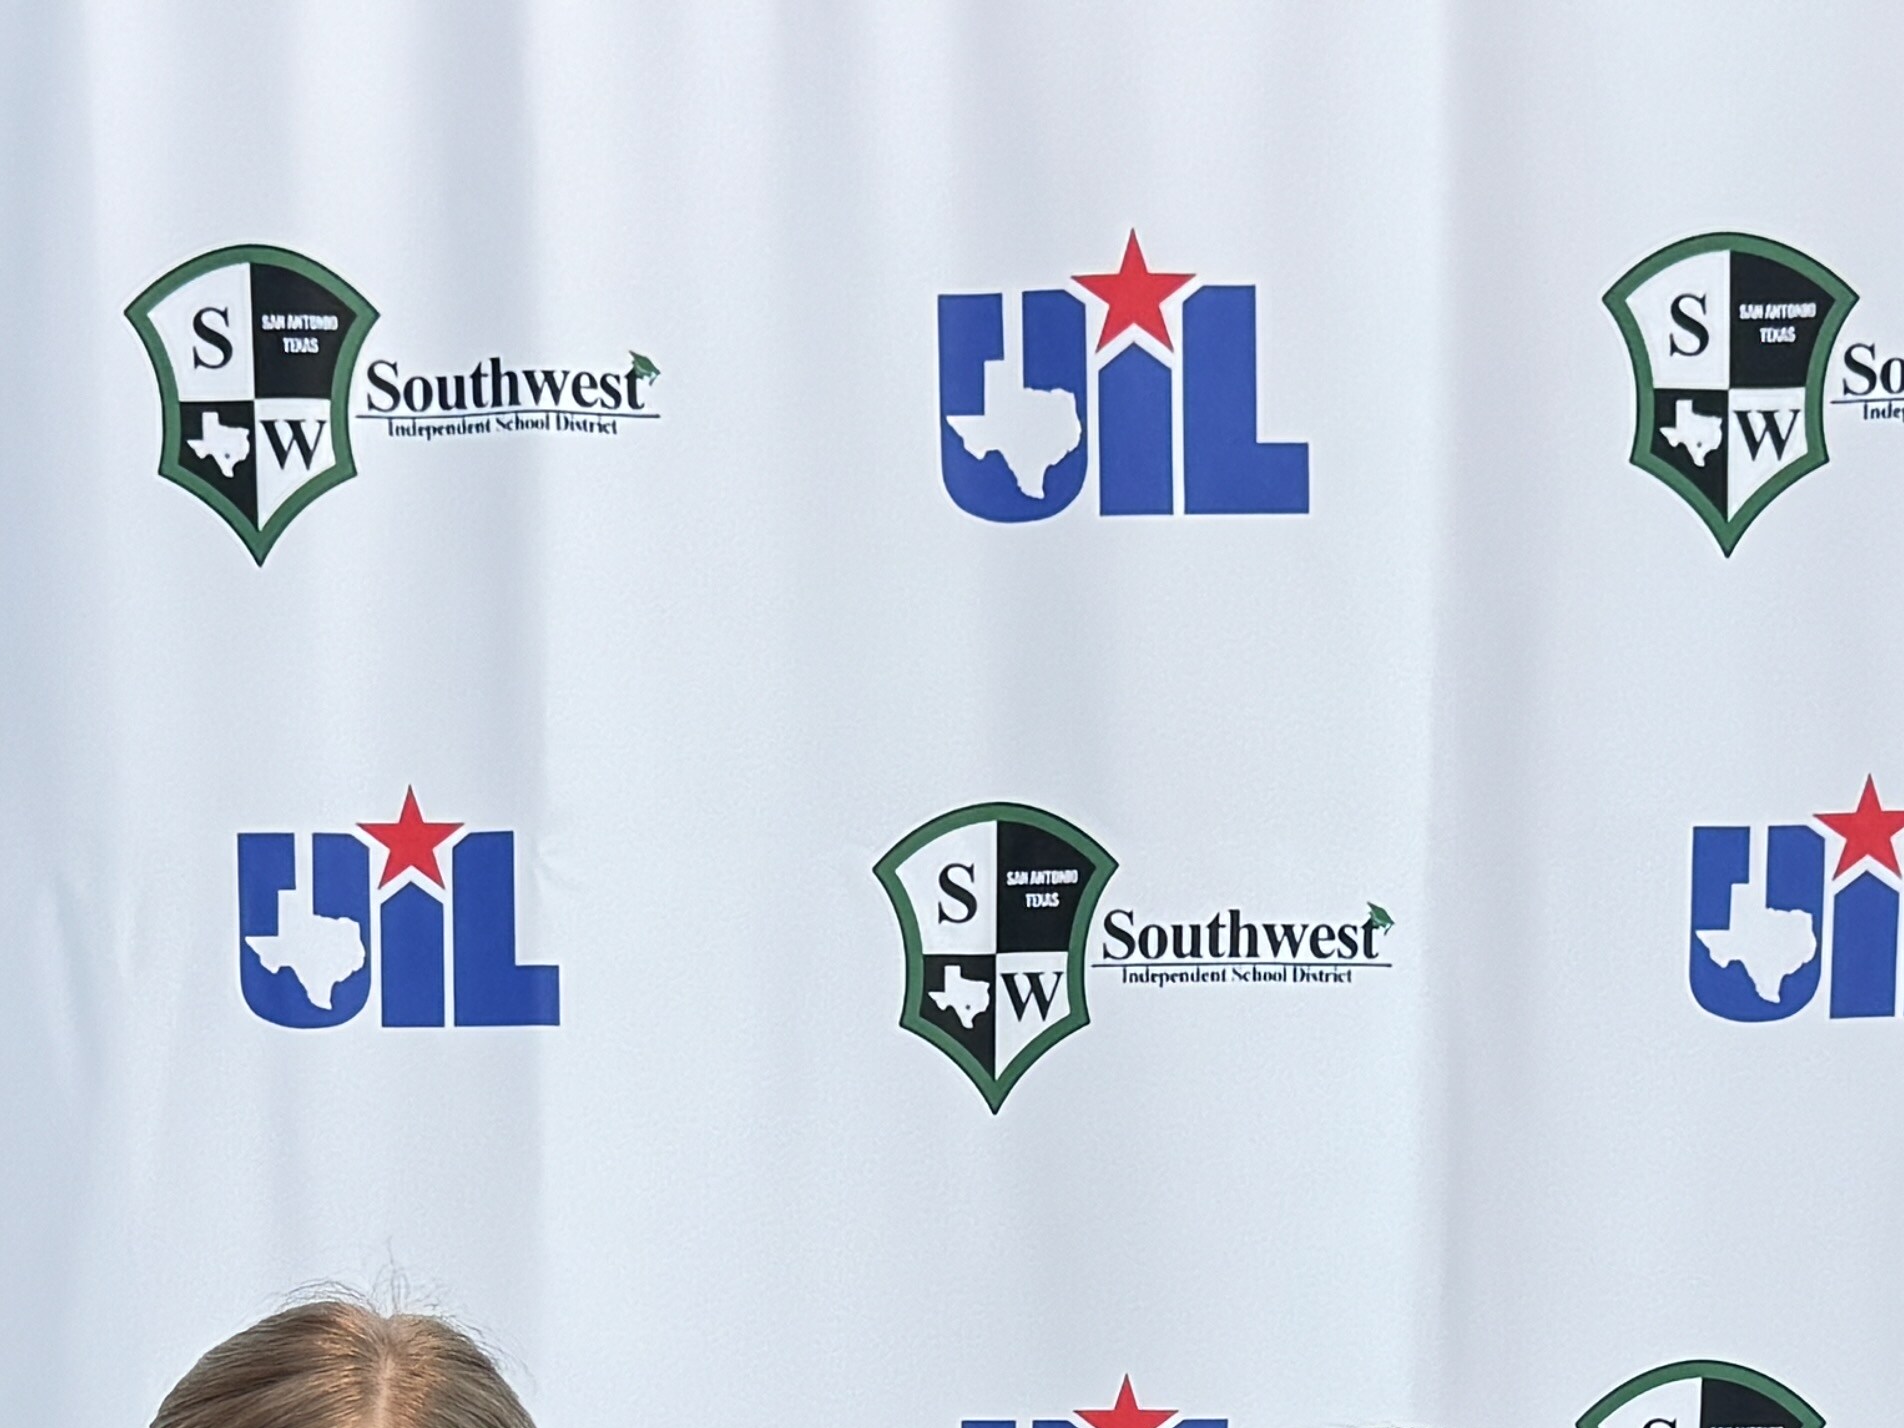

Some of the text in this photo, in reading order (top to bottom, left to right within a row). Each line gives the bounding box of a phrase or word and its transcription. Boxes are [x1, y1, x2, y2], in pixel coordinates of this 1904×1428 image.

[192, 306, 232, 370] S
[1671, 293, 1710, 358] S
[365, 351, 646, 413] Southwest
[260, 419, 325, 470] W
[1735, 409, 1800, 461] W
[937, 863, 979, 925] S
[1103, 902, 1380, 961] Southwest
[1000, 971, 1063, 1022] W
